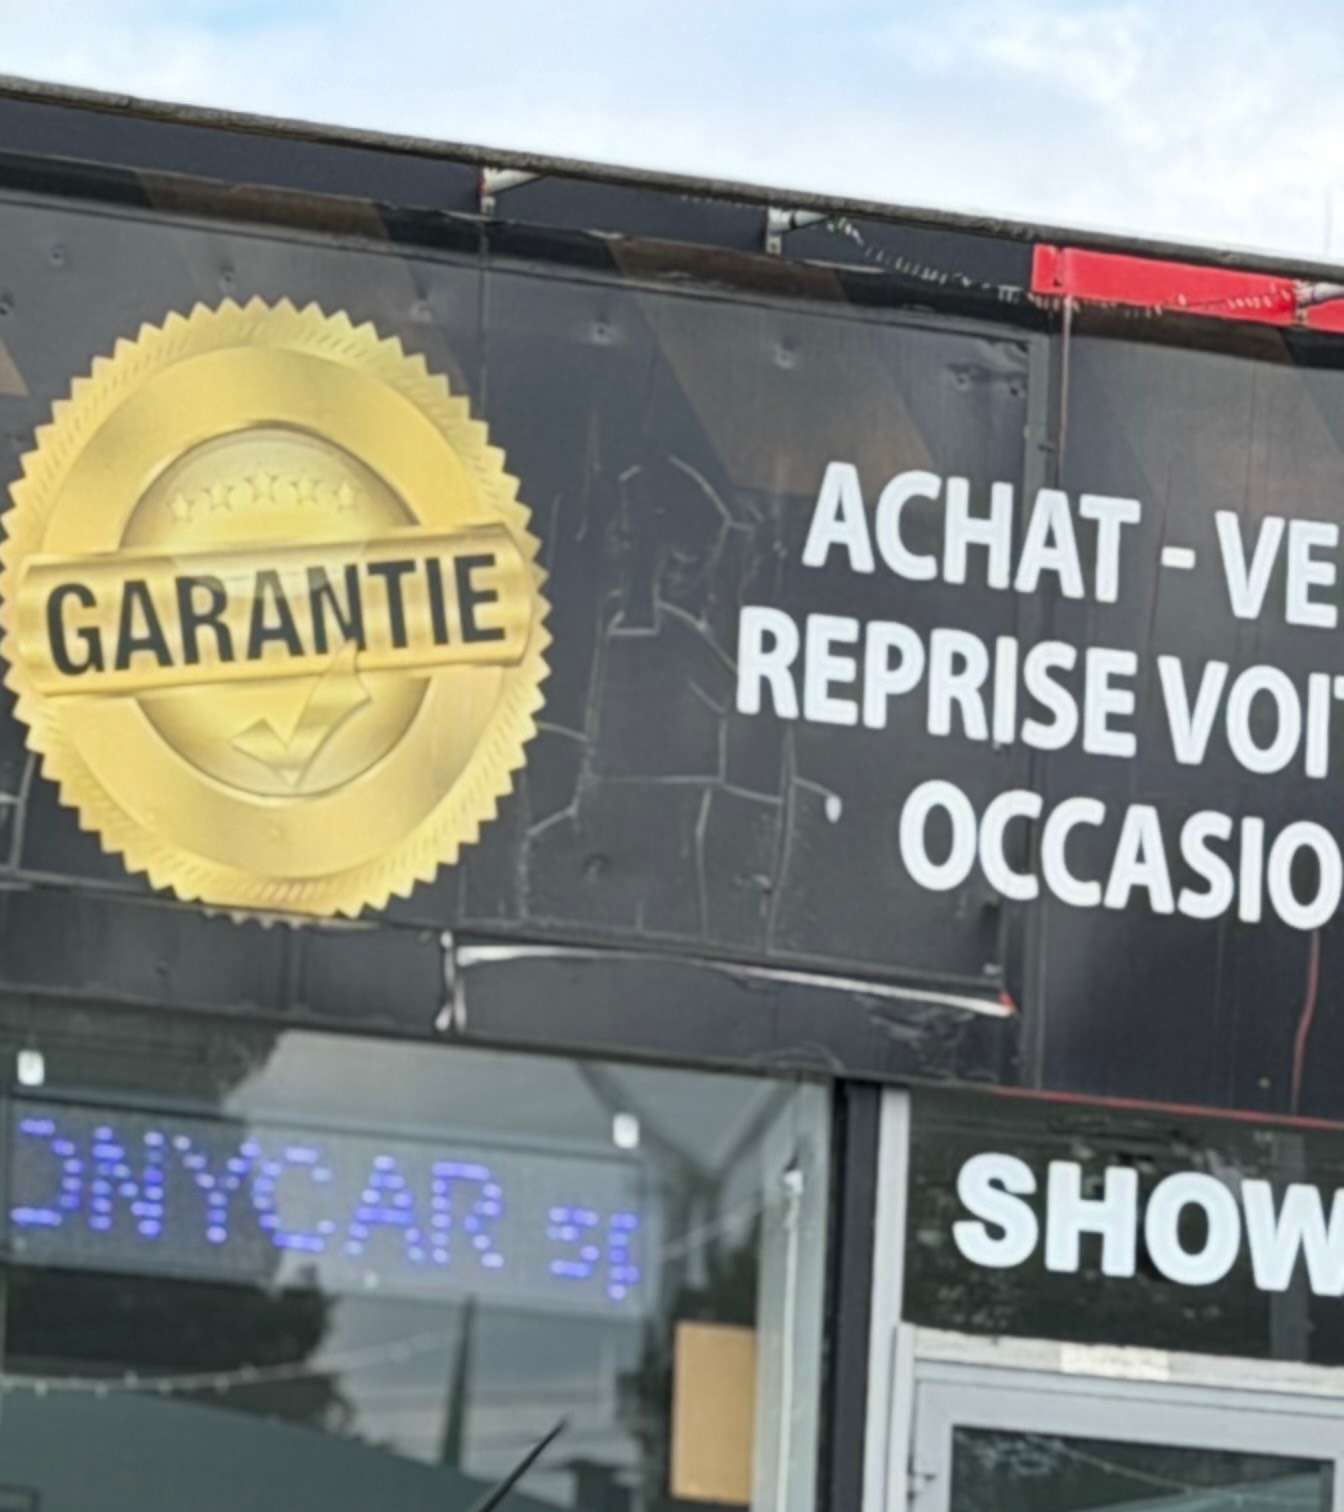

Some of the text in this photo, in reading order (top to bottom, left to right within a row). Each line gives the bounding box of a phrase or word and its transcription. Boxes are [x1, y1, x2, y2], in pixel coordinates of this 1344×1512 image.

[45, 552, 506, 677] GARANTIE
[802, 461, 1340, 628] ACHAT - VE
[736, 605, 1344, 778] REPRISE VOI
[899, 779, 1344, 931] OCCASIO
[952, 1151, 1344, 1297] SHOW
